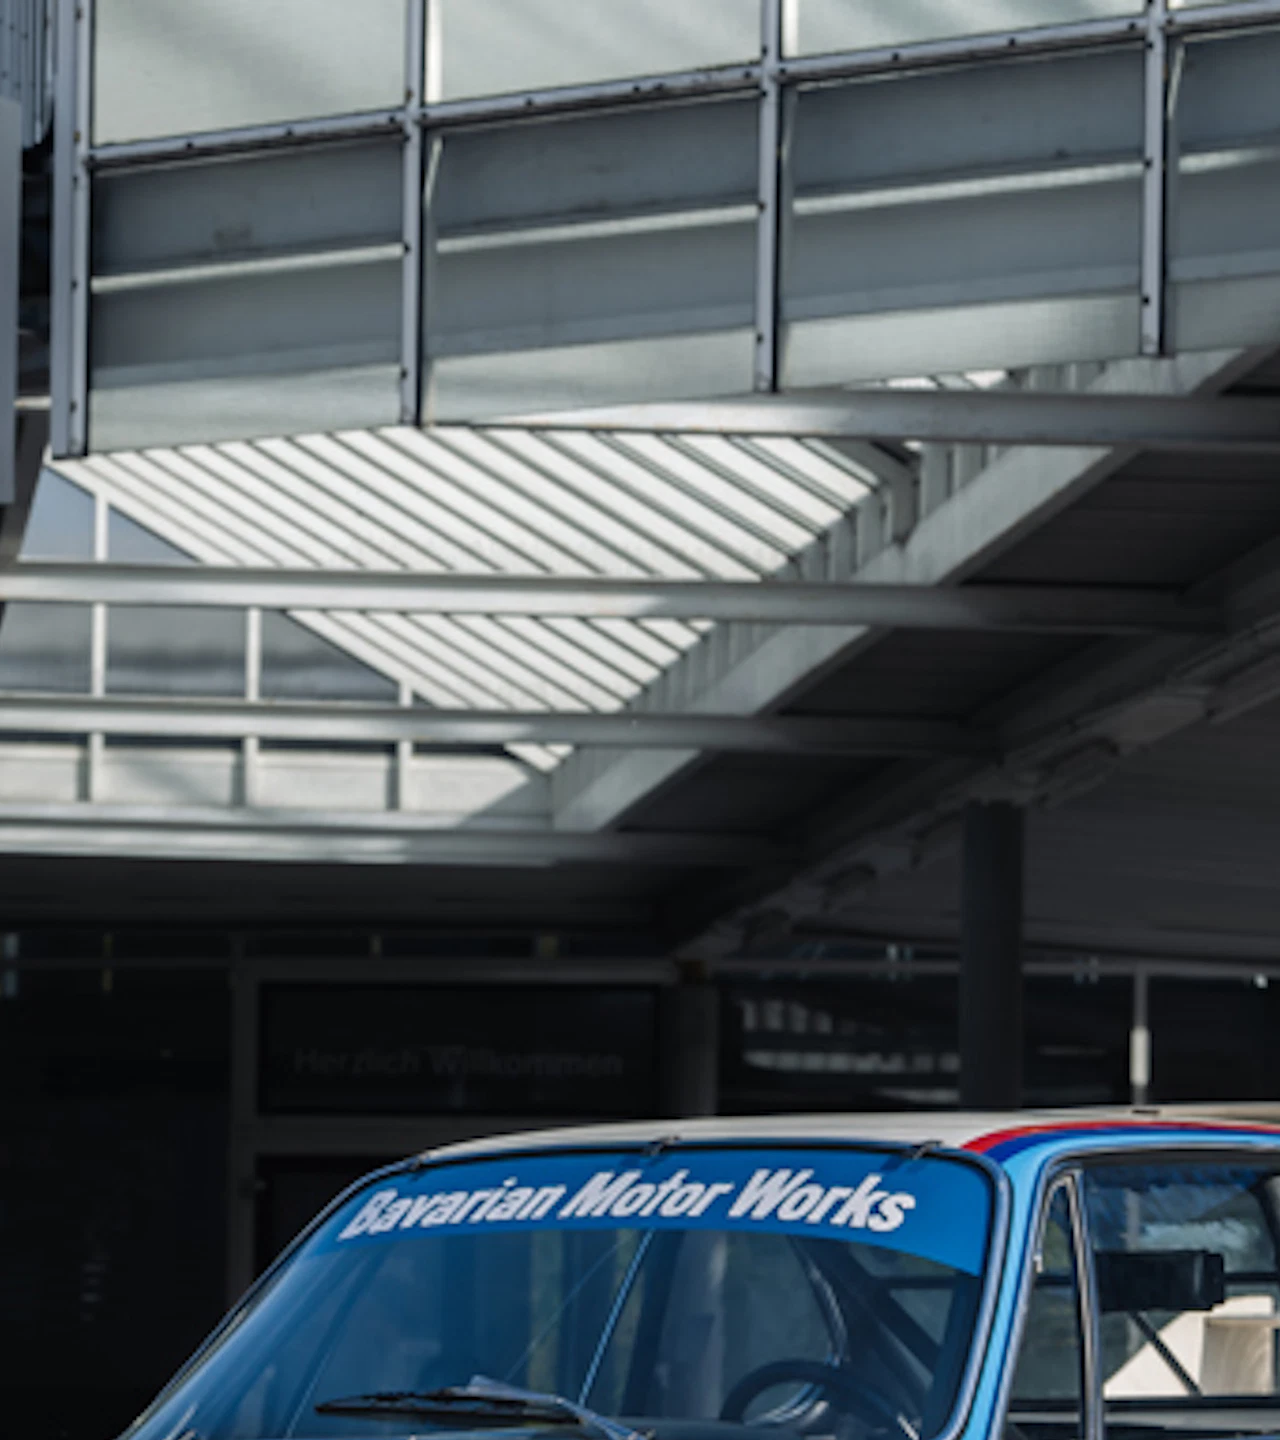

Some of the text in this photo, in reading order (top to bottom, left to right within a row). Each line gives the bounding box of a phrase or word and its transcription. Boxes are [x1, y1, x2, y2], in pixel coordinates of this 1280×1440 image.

[295, 1045, 624, 1078] Herzlich Willkommen
[338, 1167, 916, 1242] Bavarian Motor Works
